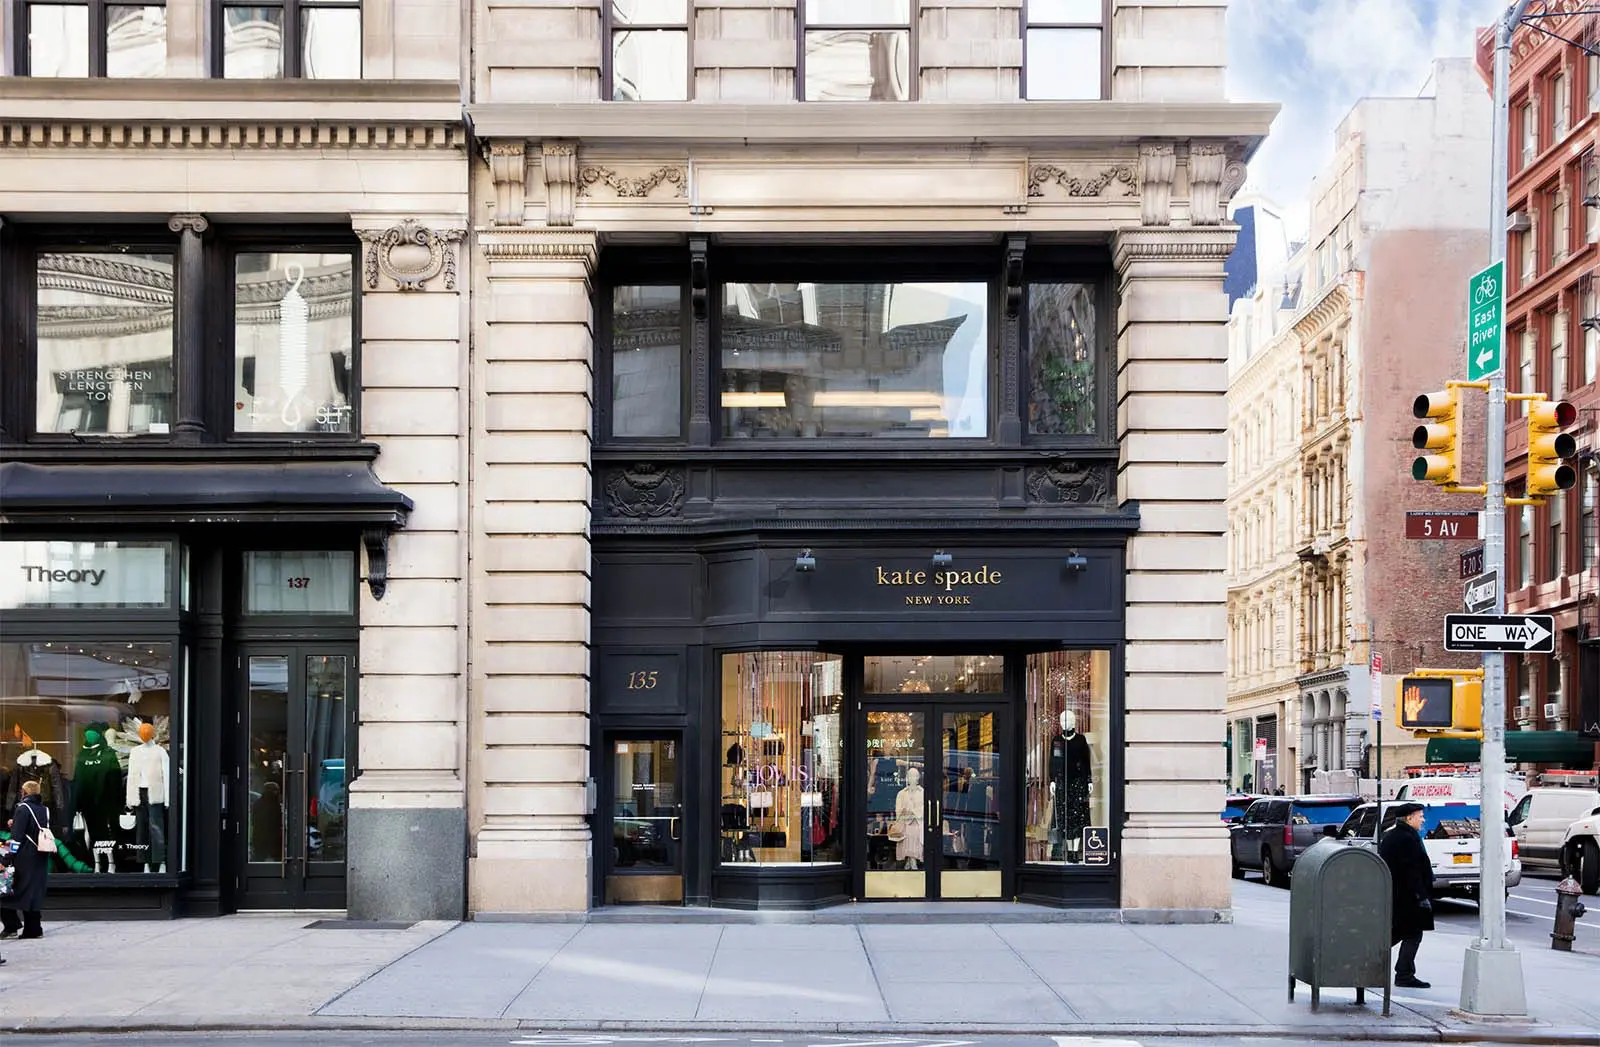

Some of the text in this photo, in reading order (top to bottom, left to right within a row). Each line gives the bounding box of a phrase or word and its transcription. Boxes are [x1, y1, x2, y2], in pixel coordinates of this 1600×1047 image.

[1474, 305, 1496, 328] East
[1472, 324, 1498, 347] River
[60, 371, 152, 380] STRENGHEN
[69, 381, 143, 391] LENGTEN
[1424, 519, 1459, 536] 5 Av
[20, 565, 106, 587] Theory
[1462, 560, 1467, 576] E
[287, 577, 311, 588] 137
[876, 565, 1002, 591] kate spade
[905, 596, 971, 605] NEW YORK
[1455, 626, 1538, 641] ONE WAY
[626, 671, 659, 689] 135
